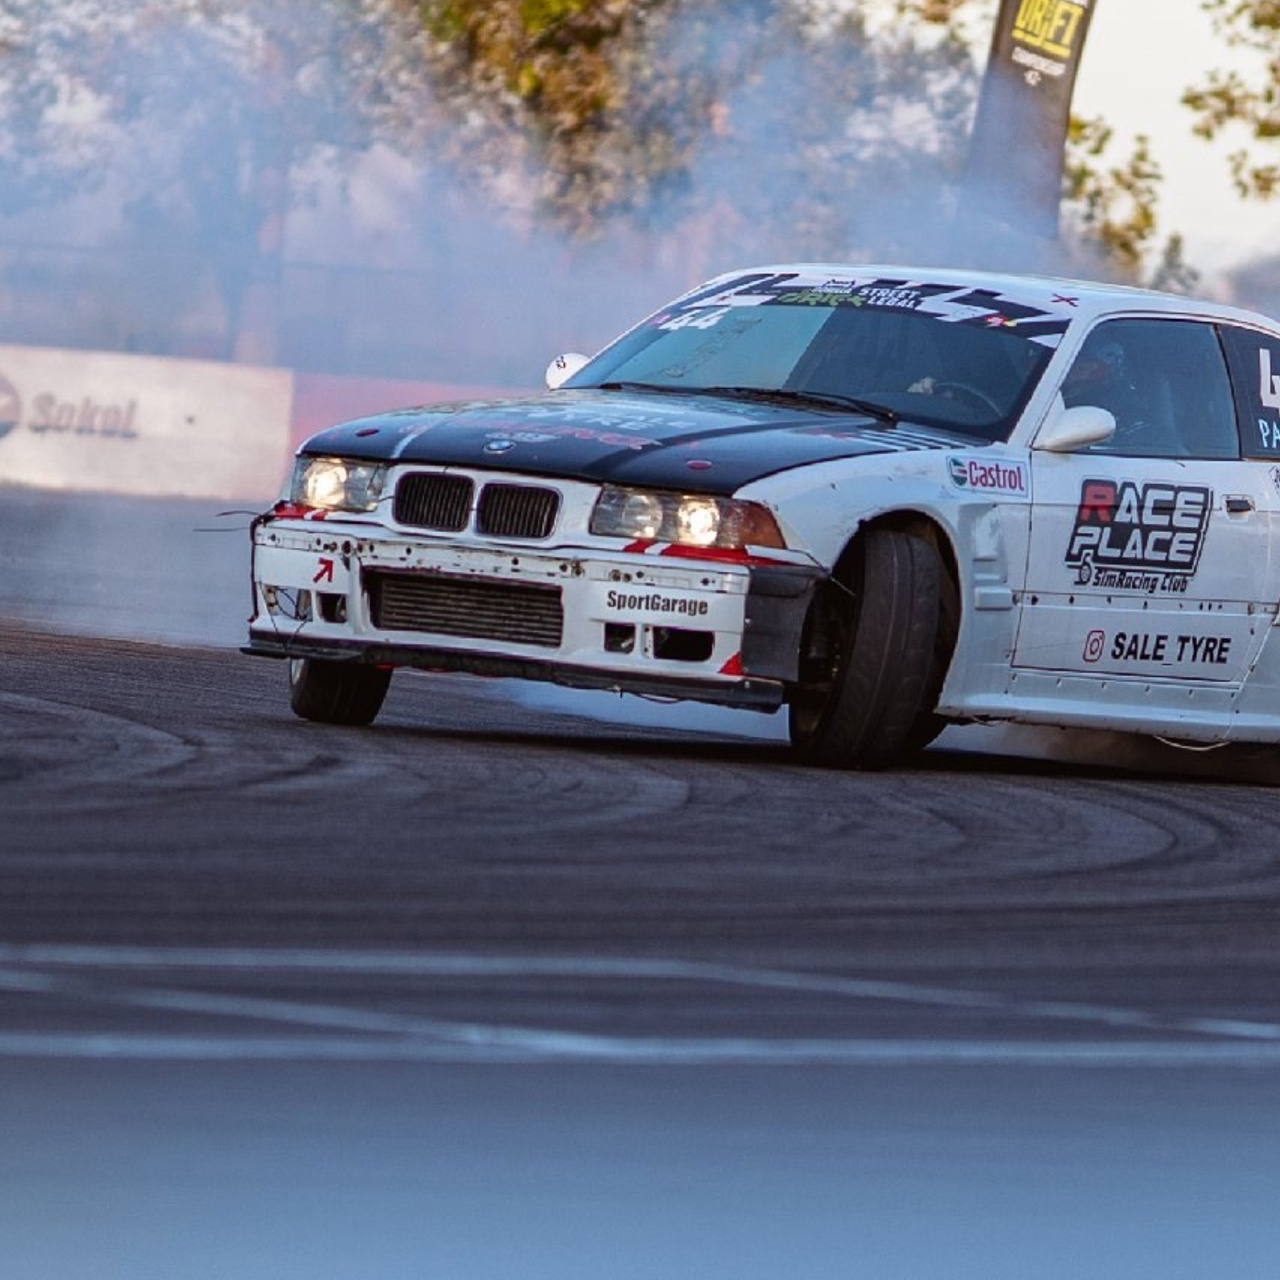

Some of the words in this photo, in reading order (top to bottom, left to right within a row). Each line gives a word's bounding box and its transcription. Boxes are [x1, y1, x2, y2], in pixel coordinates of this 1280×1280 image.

[858, 287, 921, 299] STREET
[867, 296, 916, 308] LEGAL
[658, 308, 733, 330] 44
[28, 391, 138, 440] Sokol
[969, 460, 1025, 491] Castrol
[1081, 483, 1205, 528] RACE
[1070, 525, 1198, 563] PLACE
[1092, 570, 1159, 593] SimRacing
[1160, 573, 1189, 593] Club
[606, 589, 709, 617] SportGarage
